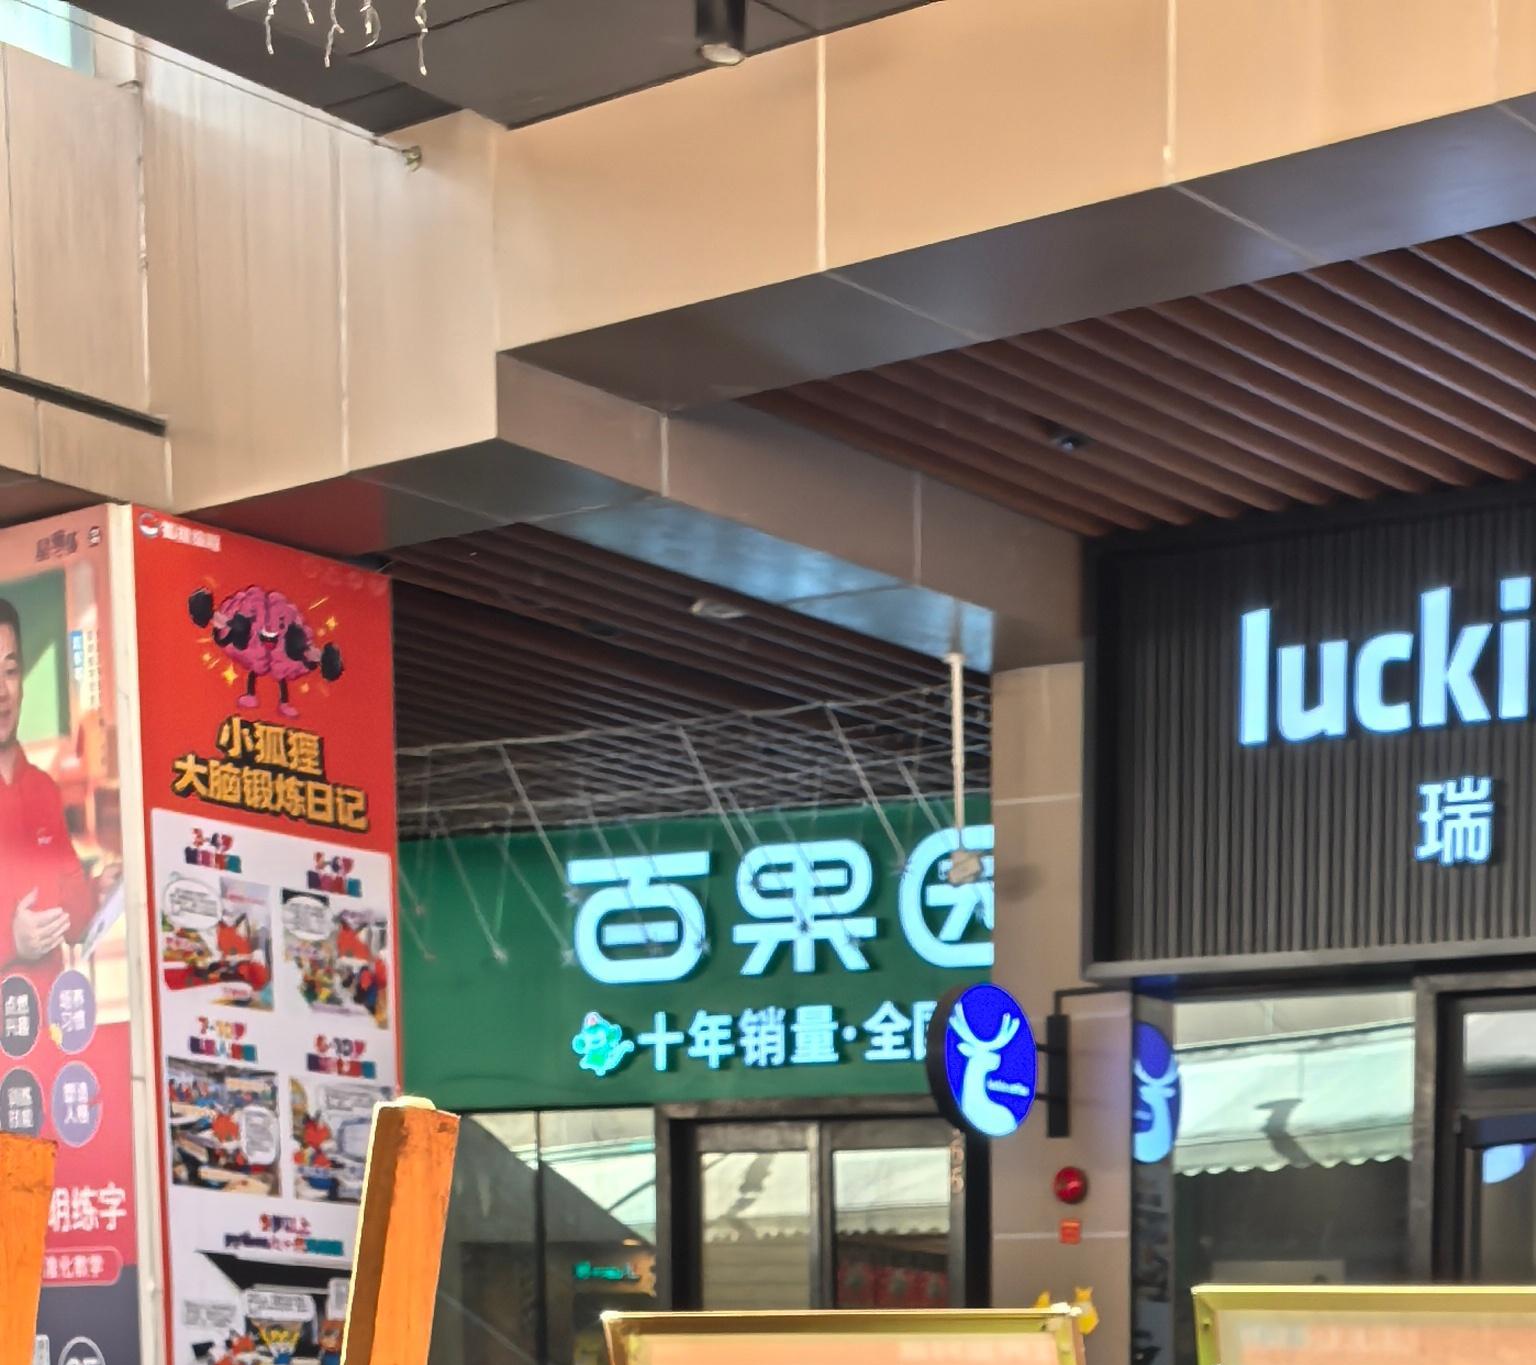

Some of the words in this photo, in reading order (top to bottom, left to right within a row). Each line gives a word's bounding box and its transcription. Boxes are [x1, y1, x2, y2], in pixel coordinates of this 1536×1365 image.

[218, 715, 321, 776] 小狐狸
[173, 752, 368, 832] 大脑锻炼日记
